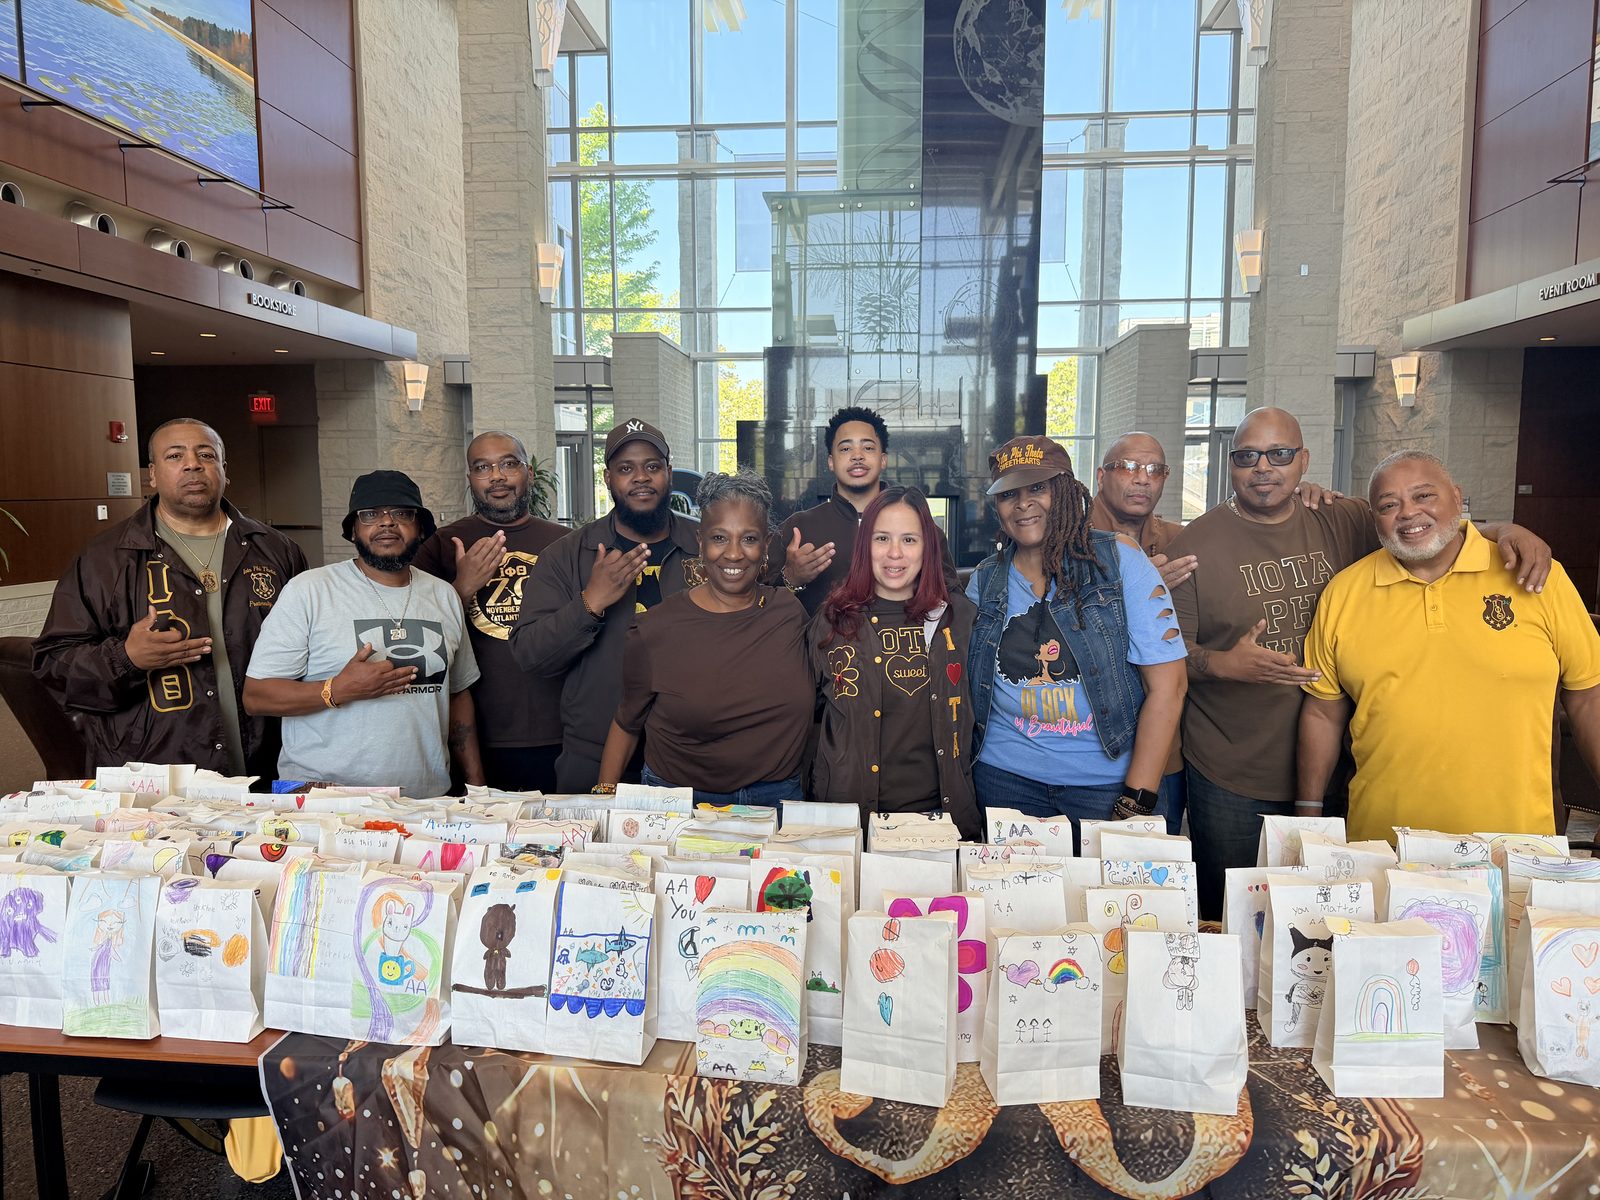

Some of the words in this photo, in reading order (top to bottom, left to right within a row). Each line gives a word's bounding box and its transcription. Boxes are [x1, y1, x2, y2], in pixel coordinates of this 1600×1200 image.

[1538, 282, 1565, 301] EVENT
[1565, 272, 1596, 293] ROOM
[252, 293, 297, 316] BOOKSTORE
[253, 397, 271, 411] EXIT
[999, 457, 1041, 473] SWEETHEARTS
[1239, 550, 1336, 597] IOTA
[486, 605, 521, 614] NOVEMBER
[493, 613, 520, 622] ATLANT
[893, 664, 928, 679] sweet
[1020, 687, 1079, 722] BLACK
[1027, 713, 1094, 738] Beautiful
[139, 779, 155, 793] AA
[1009, 823, 1033, 838] AA
[665, 878, 689, 896] AA
[404, 979, 428, 996] AA
[712, 1062, 738, 1075] AA
